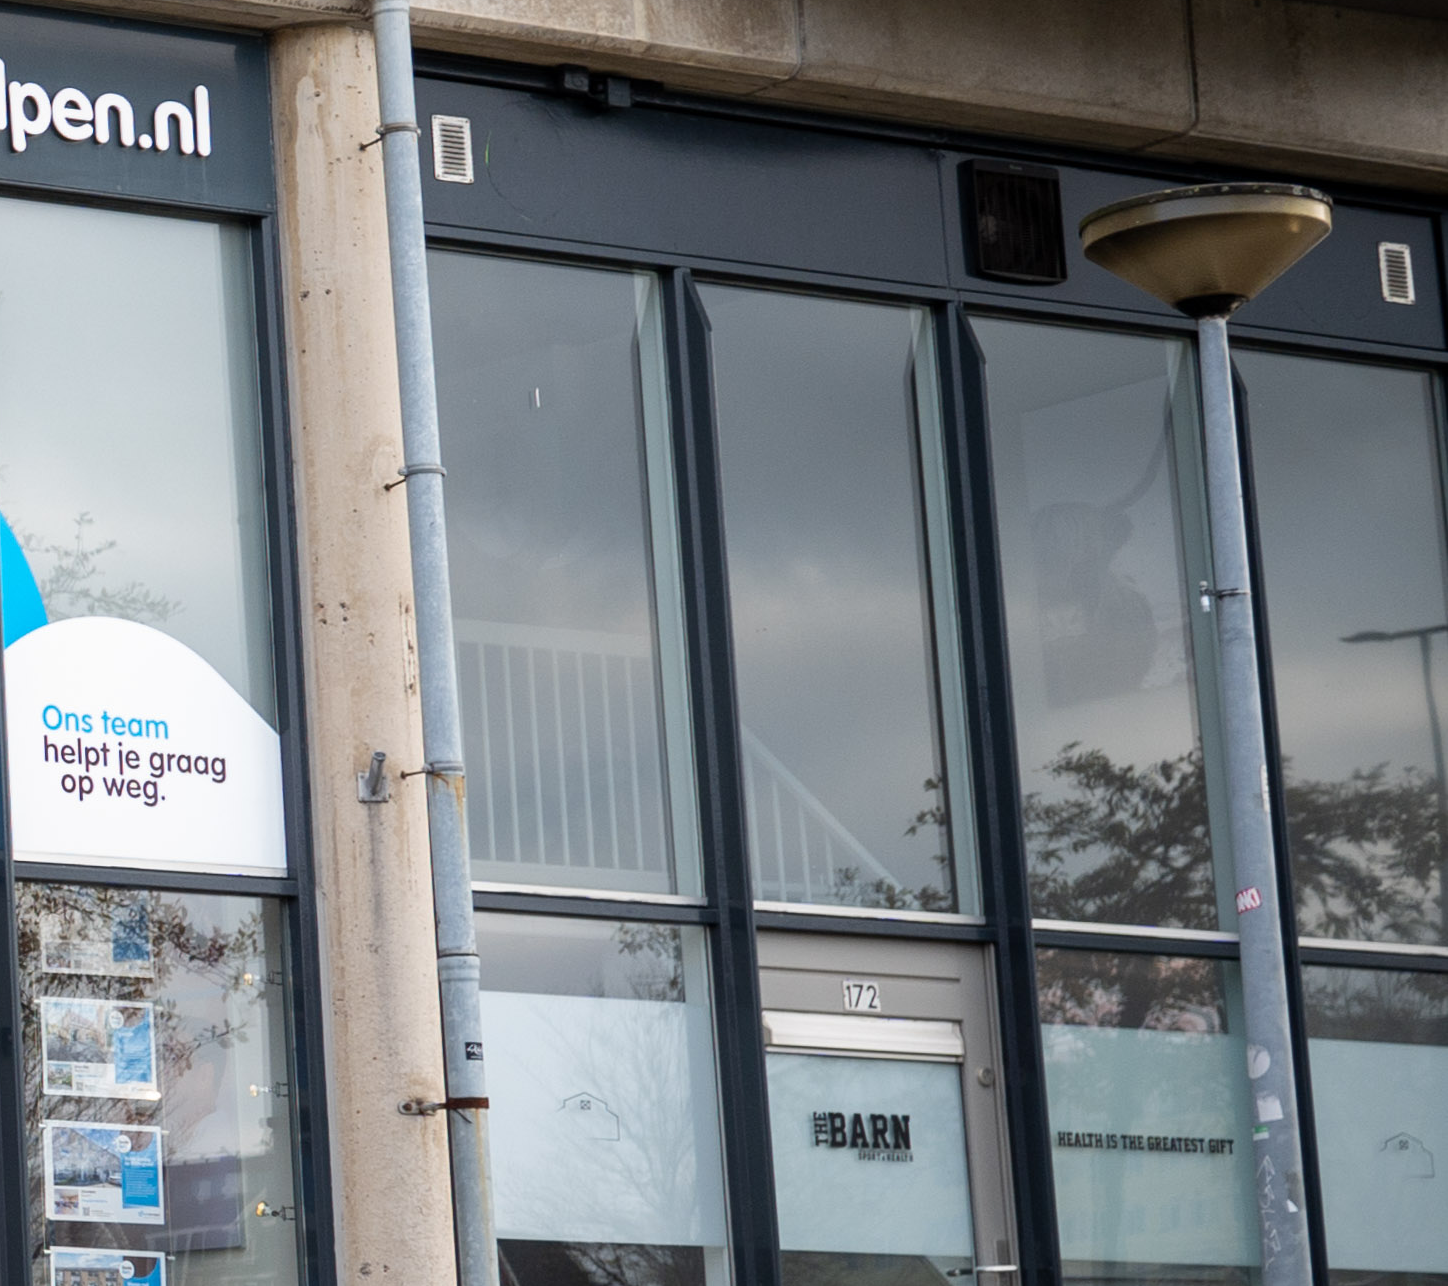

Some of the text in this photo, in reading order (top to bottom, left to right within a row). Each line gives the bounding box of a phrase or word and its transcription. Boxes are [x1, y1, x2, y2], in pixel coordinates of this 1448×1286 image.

[42, 704, 169, 740] Ons team
[44, 735, 227, 783] helpt je graag
[60, 773, 168, 807] op weg.
[845, 985, 878, 1009] 172
[813, 1111, 911, 1150] THE BARN
[1057, 1131, 1234, 1155] HEALTH IS THE GREATEST GIFT
